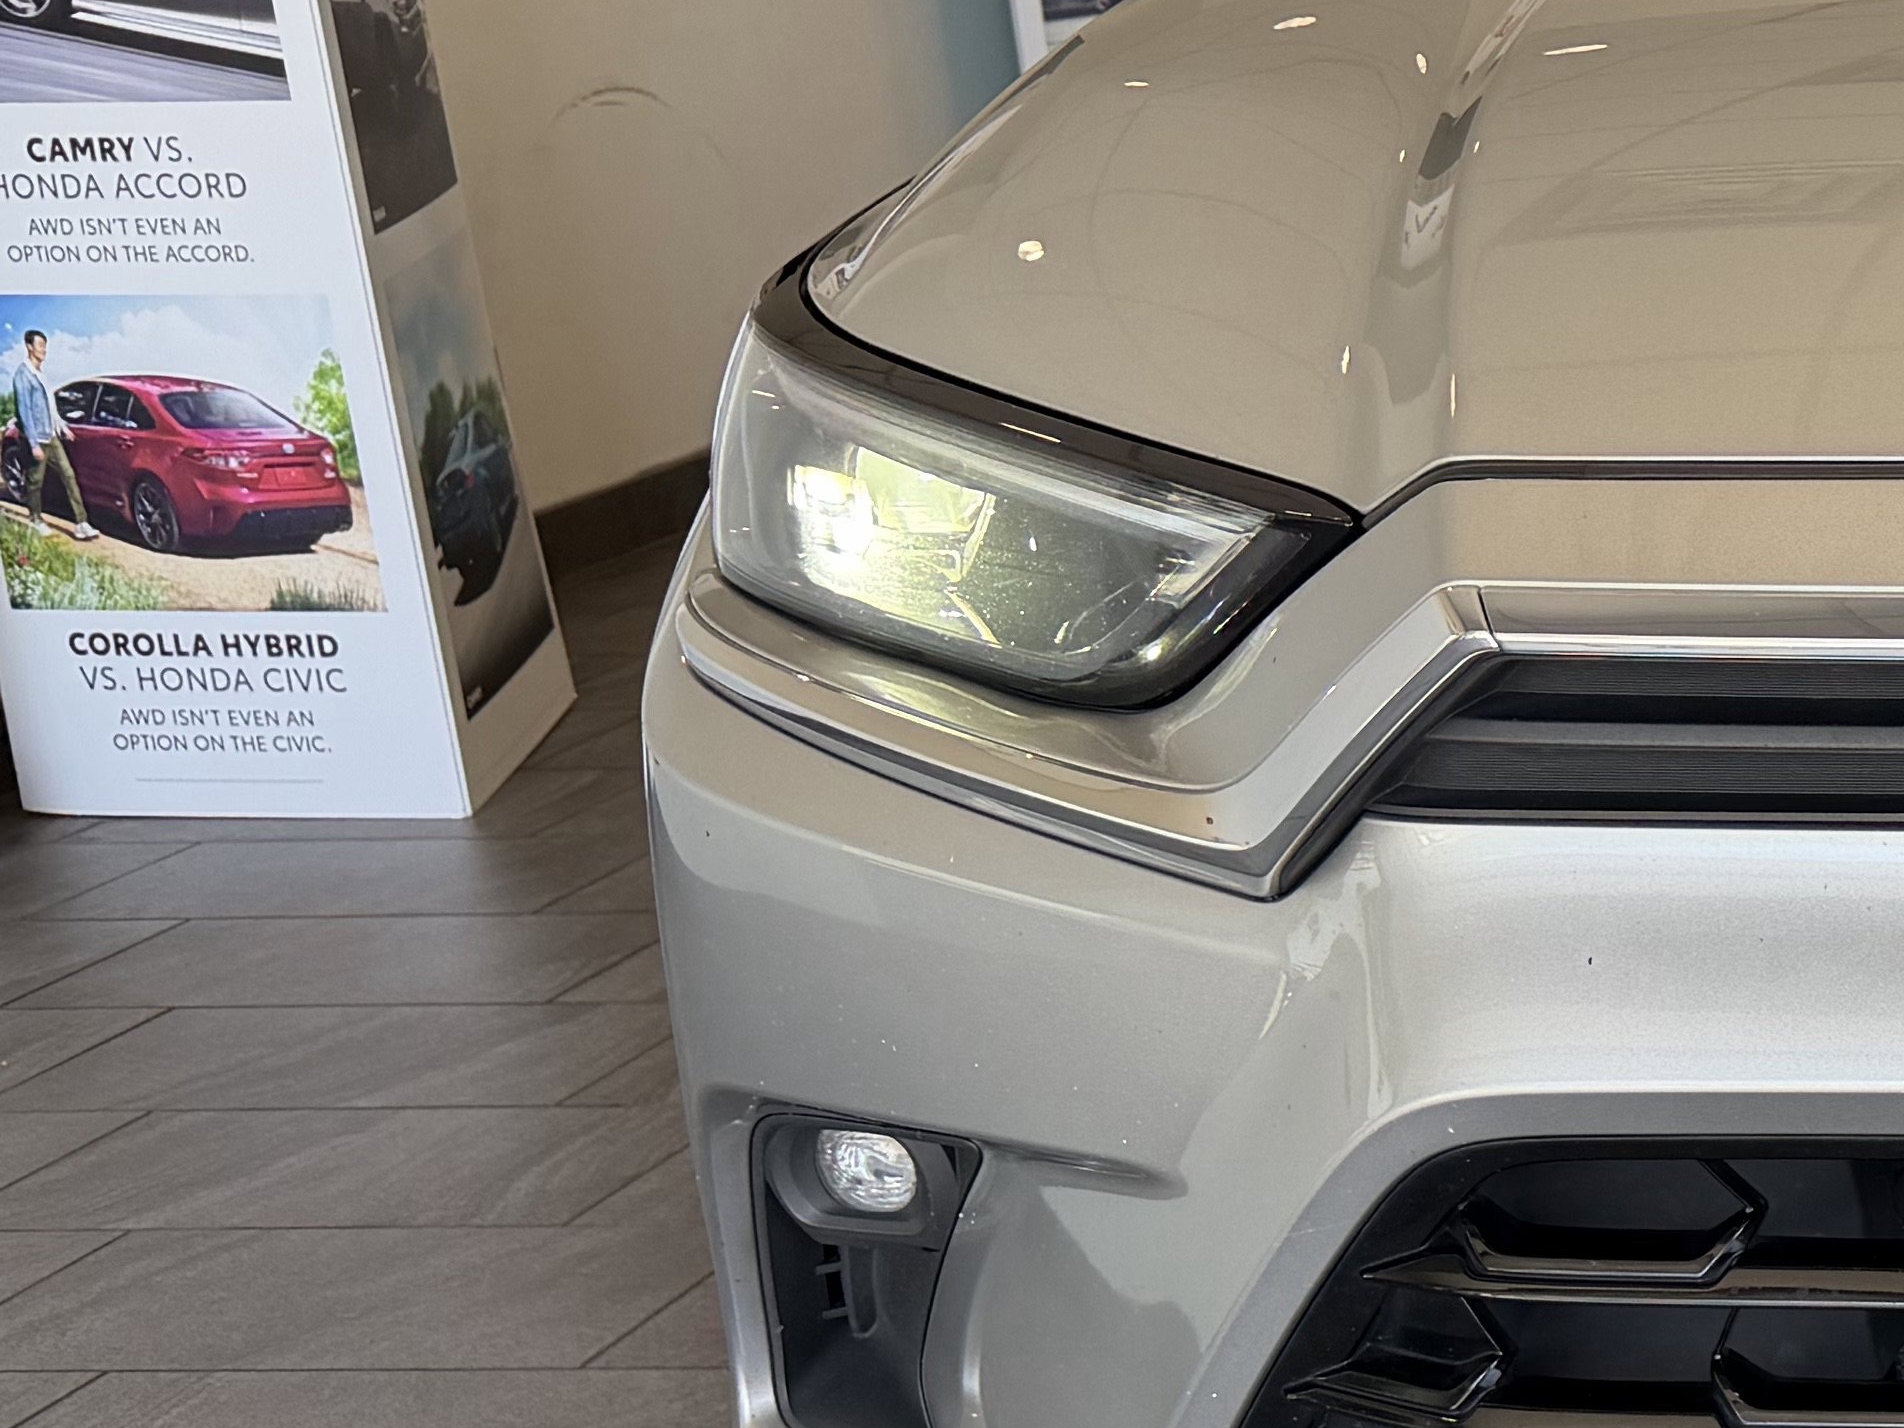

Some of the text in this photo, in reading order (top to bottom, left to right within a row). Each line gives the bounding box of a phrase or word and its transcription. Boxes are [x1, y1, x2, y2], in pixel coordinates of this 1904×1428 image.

[26, 136, 193, 163] CAMRY VS.
[115, 172, 248, 200] ACCORD
[29, 218, 222, 236] AWD ISN'T EVEN AN
[7, 245, 256, 264] OPTION ON THE ACCORD.
[68, 632, 340, 659] COROLLA HYBRID
[79, 665, 348, 693] VS. HONDA CIVIC
[120, 708, 315, 728] AWD ISN'T EVEN AN
[113, 733, 333, 754] OPTION ON THE CIVIC.
